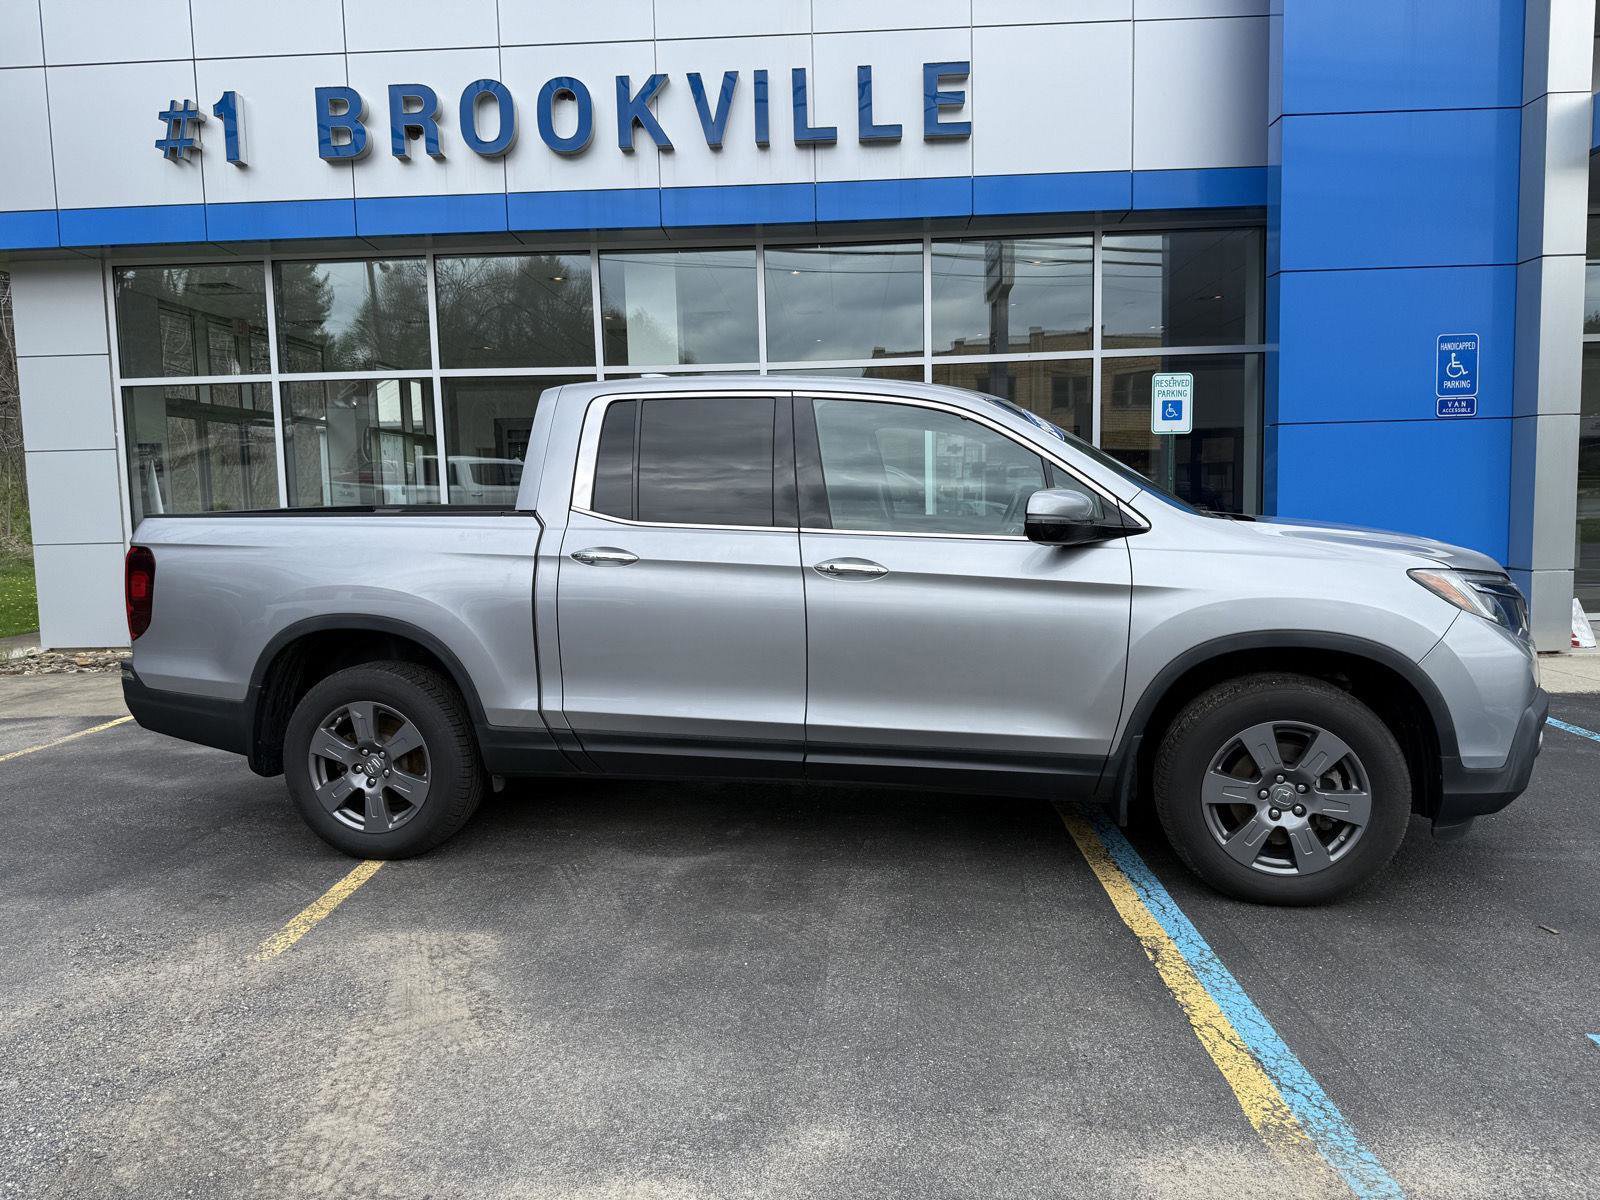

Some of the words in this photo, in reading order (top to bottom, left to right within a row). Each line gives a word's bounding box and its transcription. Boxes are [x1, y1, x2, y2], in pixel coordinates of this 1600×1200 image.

[155, 90, 246, 168] #1
[315, 61, 972, 163] BROOKVILLE
[1440, 341, 1475, 350] HANDICAPPED
[1155, 379, 1189, 387] RESERVED
[1443, 380, 1471, 388] PARKING
[1157, 389, 1188, 397] PARKING
